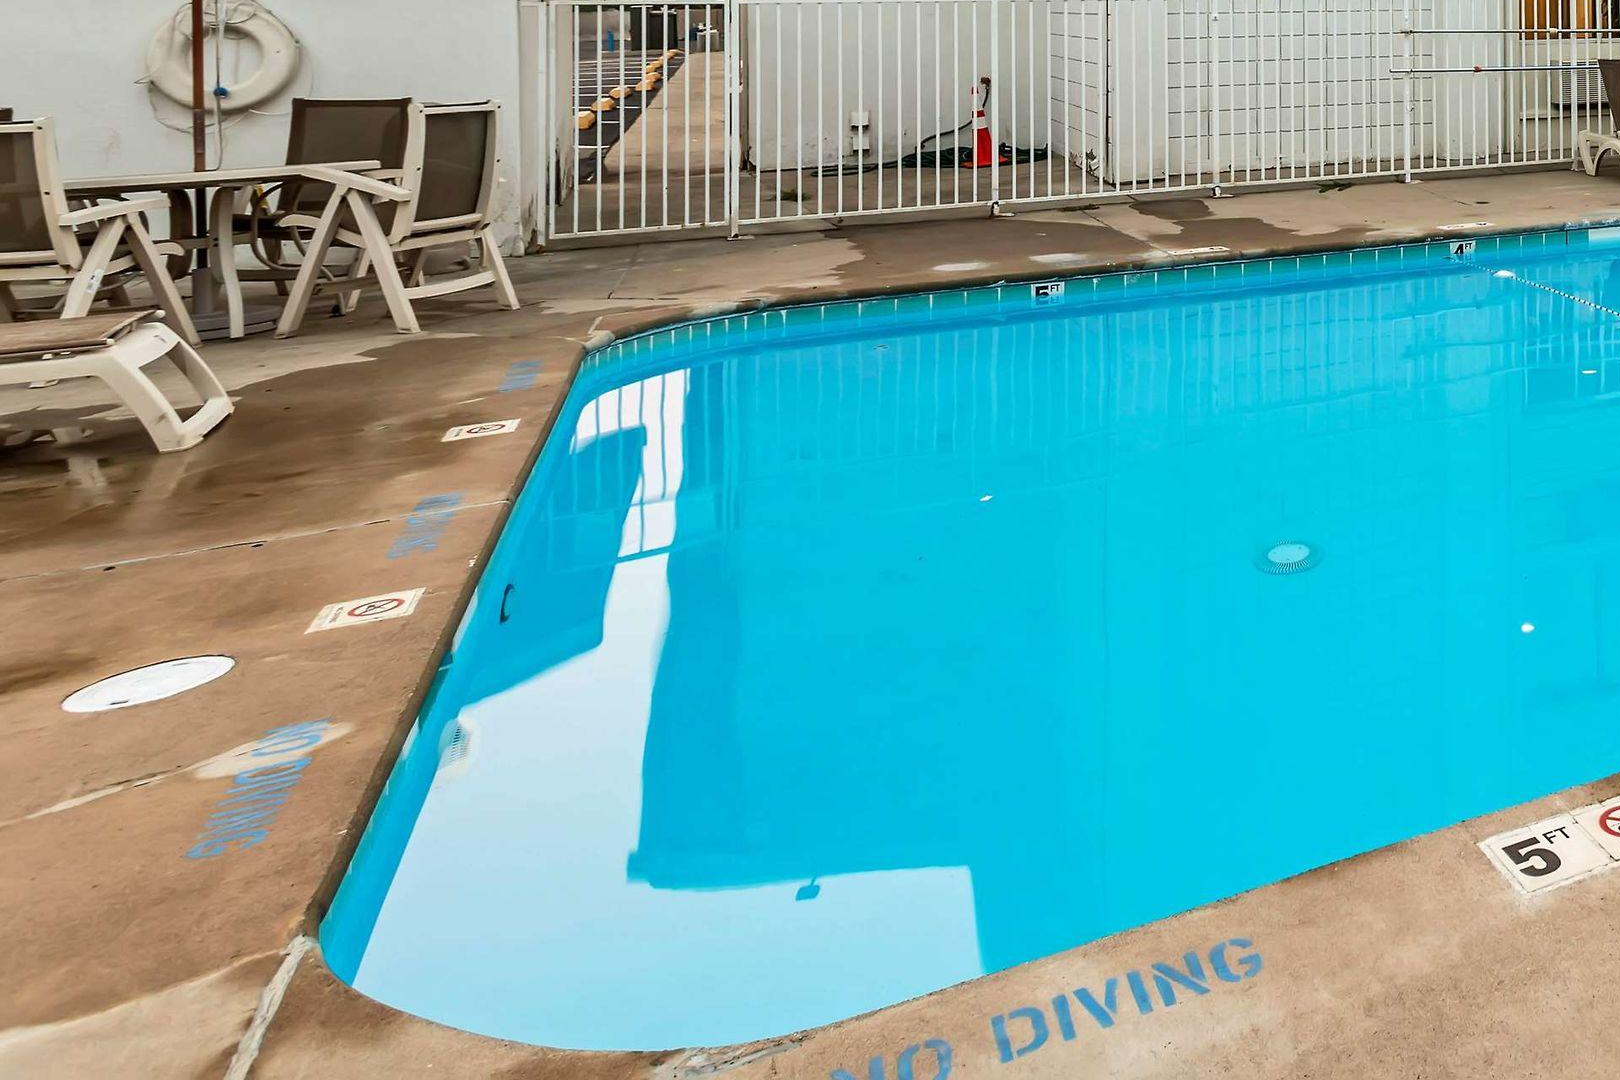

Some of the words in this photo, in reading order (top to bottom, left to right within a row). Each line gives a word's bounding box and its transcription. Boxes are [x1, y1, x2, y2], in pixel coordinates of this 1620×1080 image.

[1464, 242, 1473, 250] FT
[1050, 284, 1061, 292] FT
[1501, 836, 1562, 877] 5
[1541, 826, 1573, 845] FT
[990, 937, 1264, 1064] DIVING
